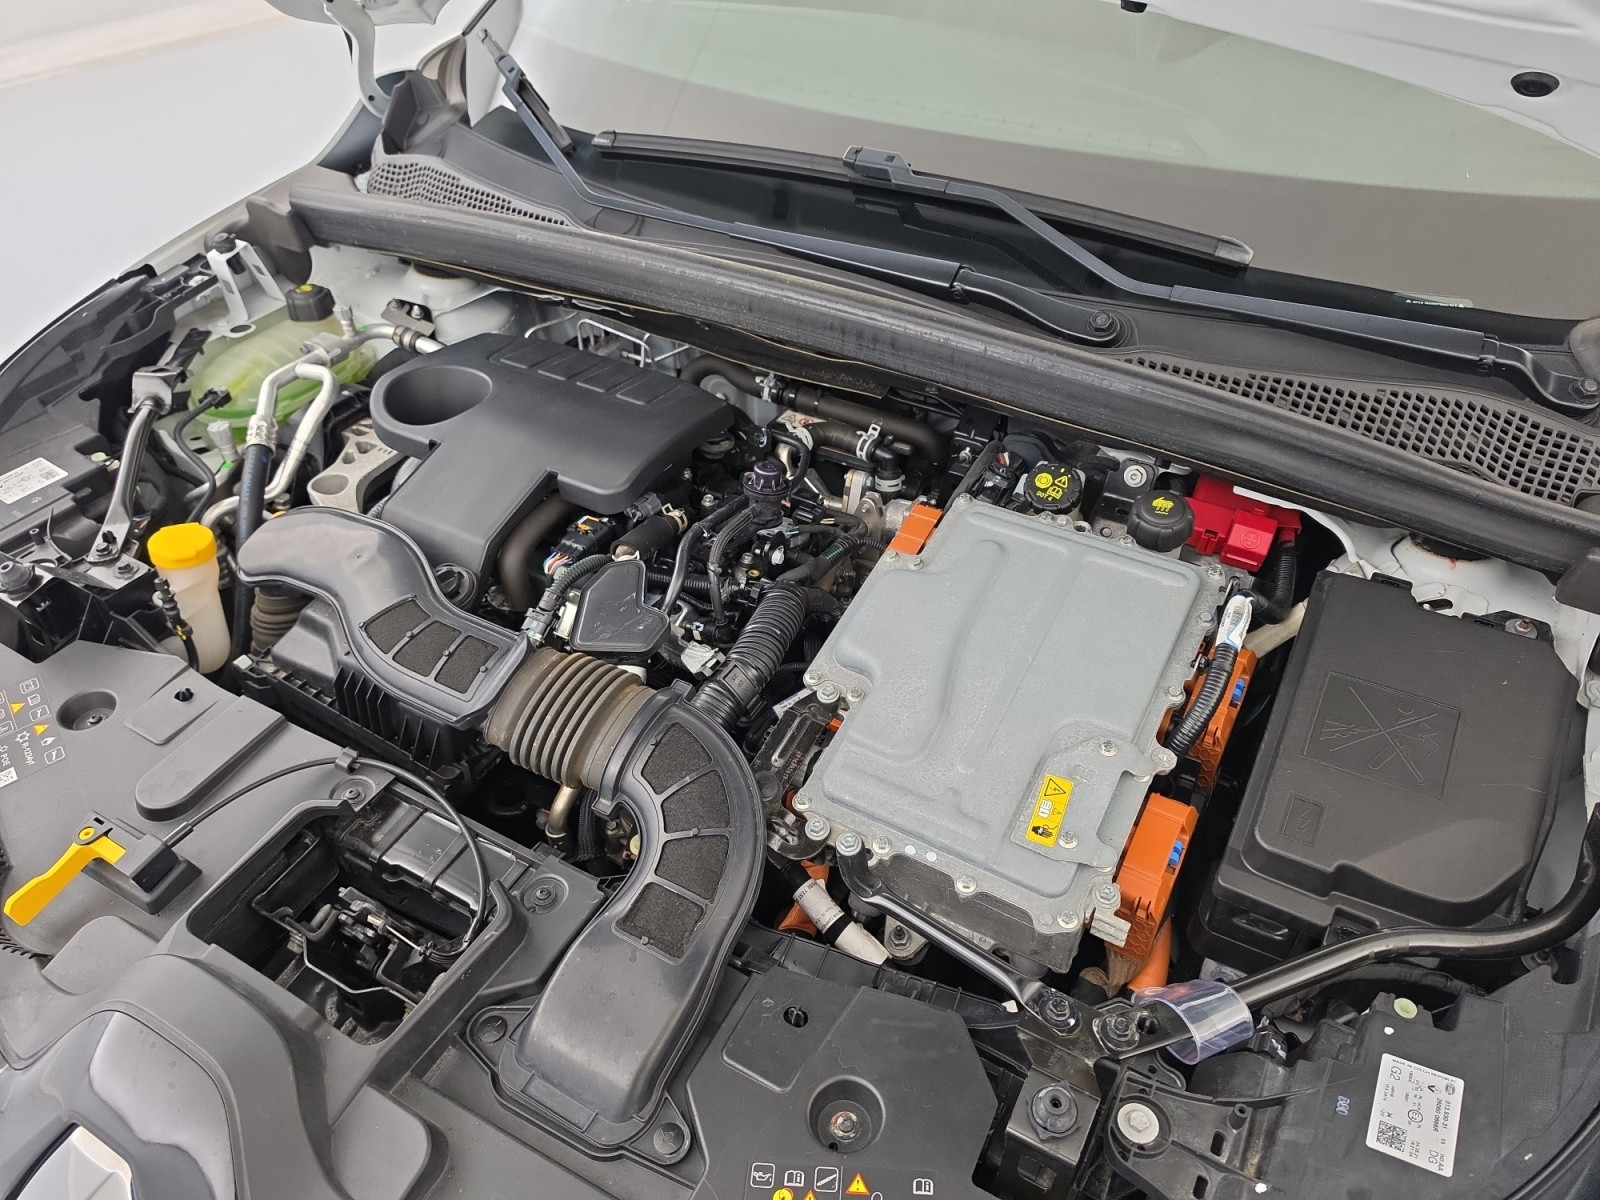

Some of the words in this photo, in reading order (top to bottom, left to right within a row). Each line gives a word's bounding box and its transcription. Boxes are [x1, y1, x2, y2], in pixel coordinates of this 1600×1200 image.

[1036, 490, 1048, 499] DOT
[0, 753, 10, 767] POE
[1389, 1066, 1402, 1081] G2
[1428, 1149, 1439, 1164] DG
